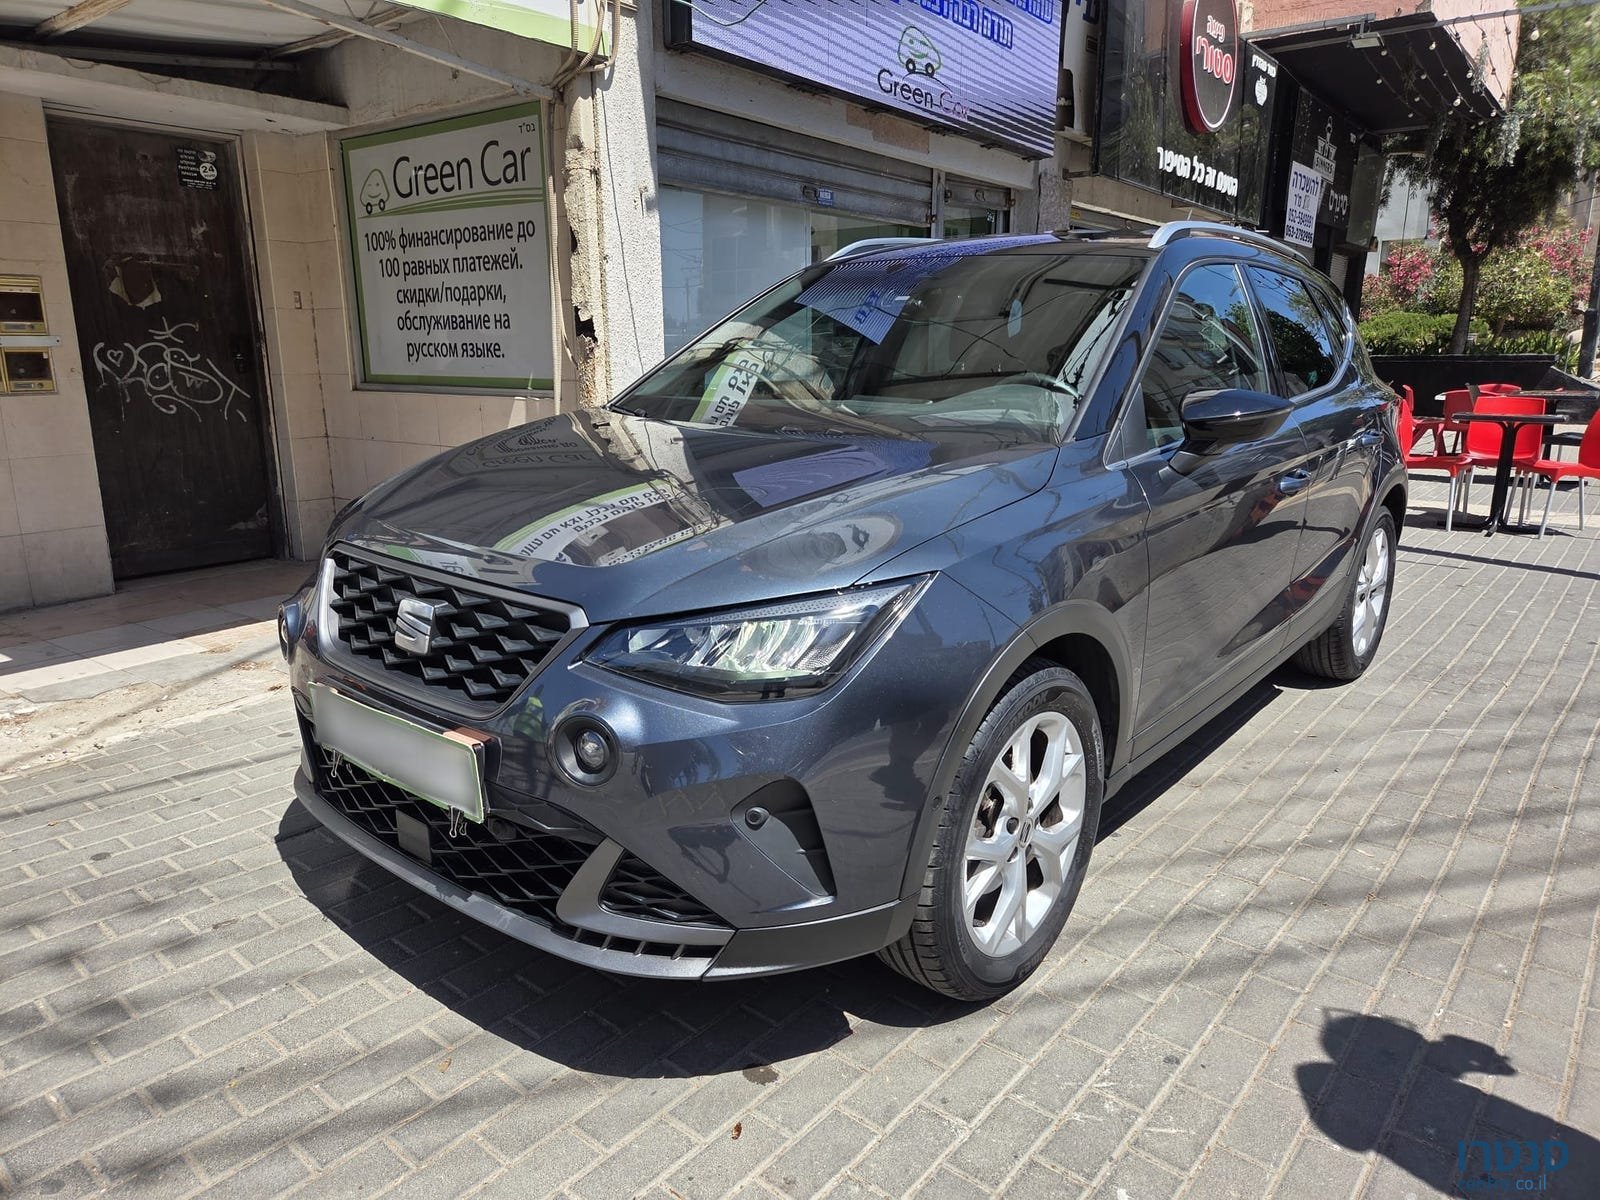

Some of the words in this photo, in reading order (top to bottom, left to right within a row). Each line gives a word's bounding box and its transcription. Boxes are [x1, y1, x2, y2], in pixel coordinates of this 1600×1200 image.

[1206, 14, 1226, 43] פיצה
[1195, 35, 1233, 85] סטורי
[877, 68, 934, 109] Green
[392, 155, 474, 199] Green
[480, 139, 532, 187] Car
[1156, 146, 1192, 179] הסיפור
[1191, 155, 1205, 184] כל
[1204, 166, 1217, 188] זה
[1292, 171, 1319, 197] להשכרה
[364, 229, 397, 252] 100%
[399, 221, 514, 254] финансирование
[517, 219, 536, 243] до
[378, 257, 400, 278] 100
[403, 257, 451, 282] равных
[452, 247, 524, 273] платежей.
[396, 281, 507, 307] скидки/подарки,
[397, 309, 491, 336] обслуживание
[494, 312, 511, 330] на
[406, 341, 459, 362] русском
[461, 341, 505, 359] языке.
